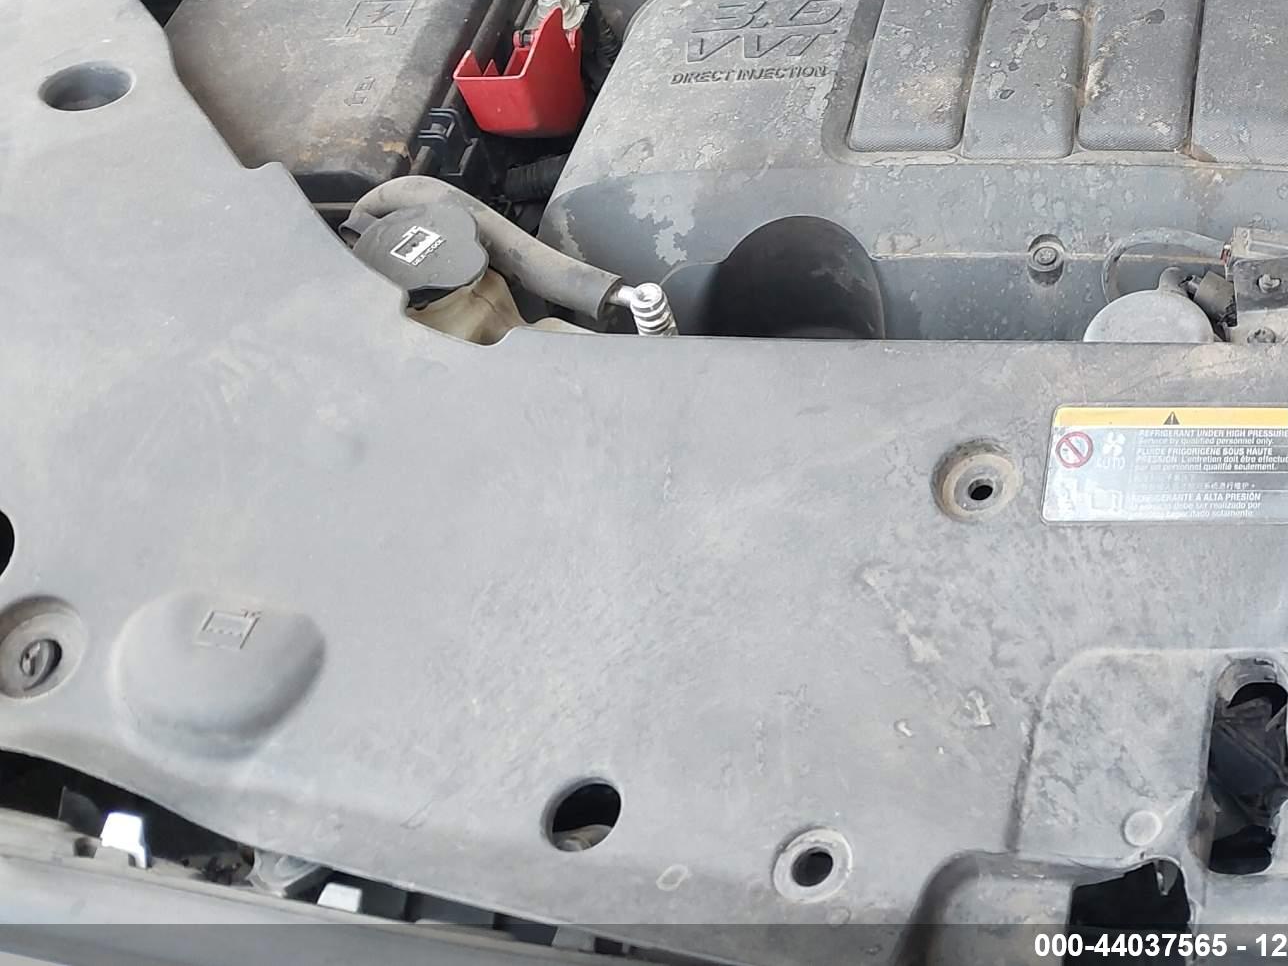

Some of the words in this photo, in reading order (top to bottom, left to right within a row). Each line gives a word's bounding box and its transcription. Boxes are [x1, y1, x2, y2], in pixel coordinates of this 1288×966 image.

[670, 69, 736, 85] DIRECT
[736, 65, 828, 82] INJECTION
[1138, 429, 1195, 438] REFRIGERANT
[1196, 429, 1225, 438] UNDER
[1225, 429, 1246, 438] HIGH
[1247, 429, 1288, 439] PRESSURE
[1180, 437, 1215, 446] qualified
[1216, 437, 1254, 445] personnel
[1255, 437, 1275, 446] only.
[1222, 447, 1245, 456] SOUS
[1246, 447, 1273, 456] HAUTE
[1223, 455, 1239, 463] doit
[1203, 463, 1232, 472] qualifié
[1195, 493, 1202, 501] A
[1203, 493, 1224, 501] ALTA
[1225, 491, 1261, 502] PRESIÓN
[1247, 502, 1261, 511] por
